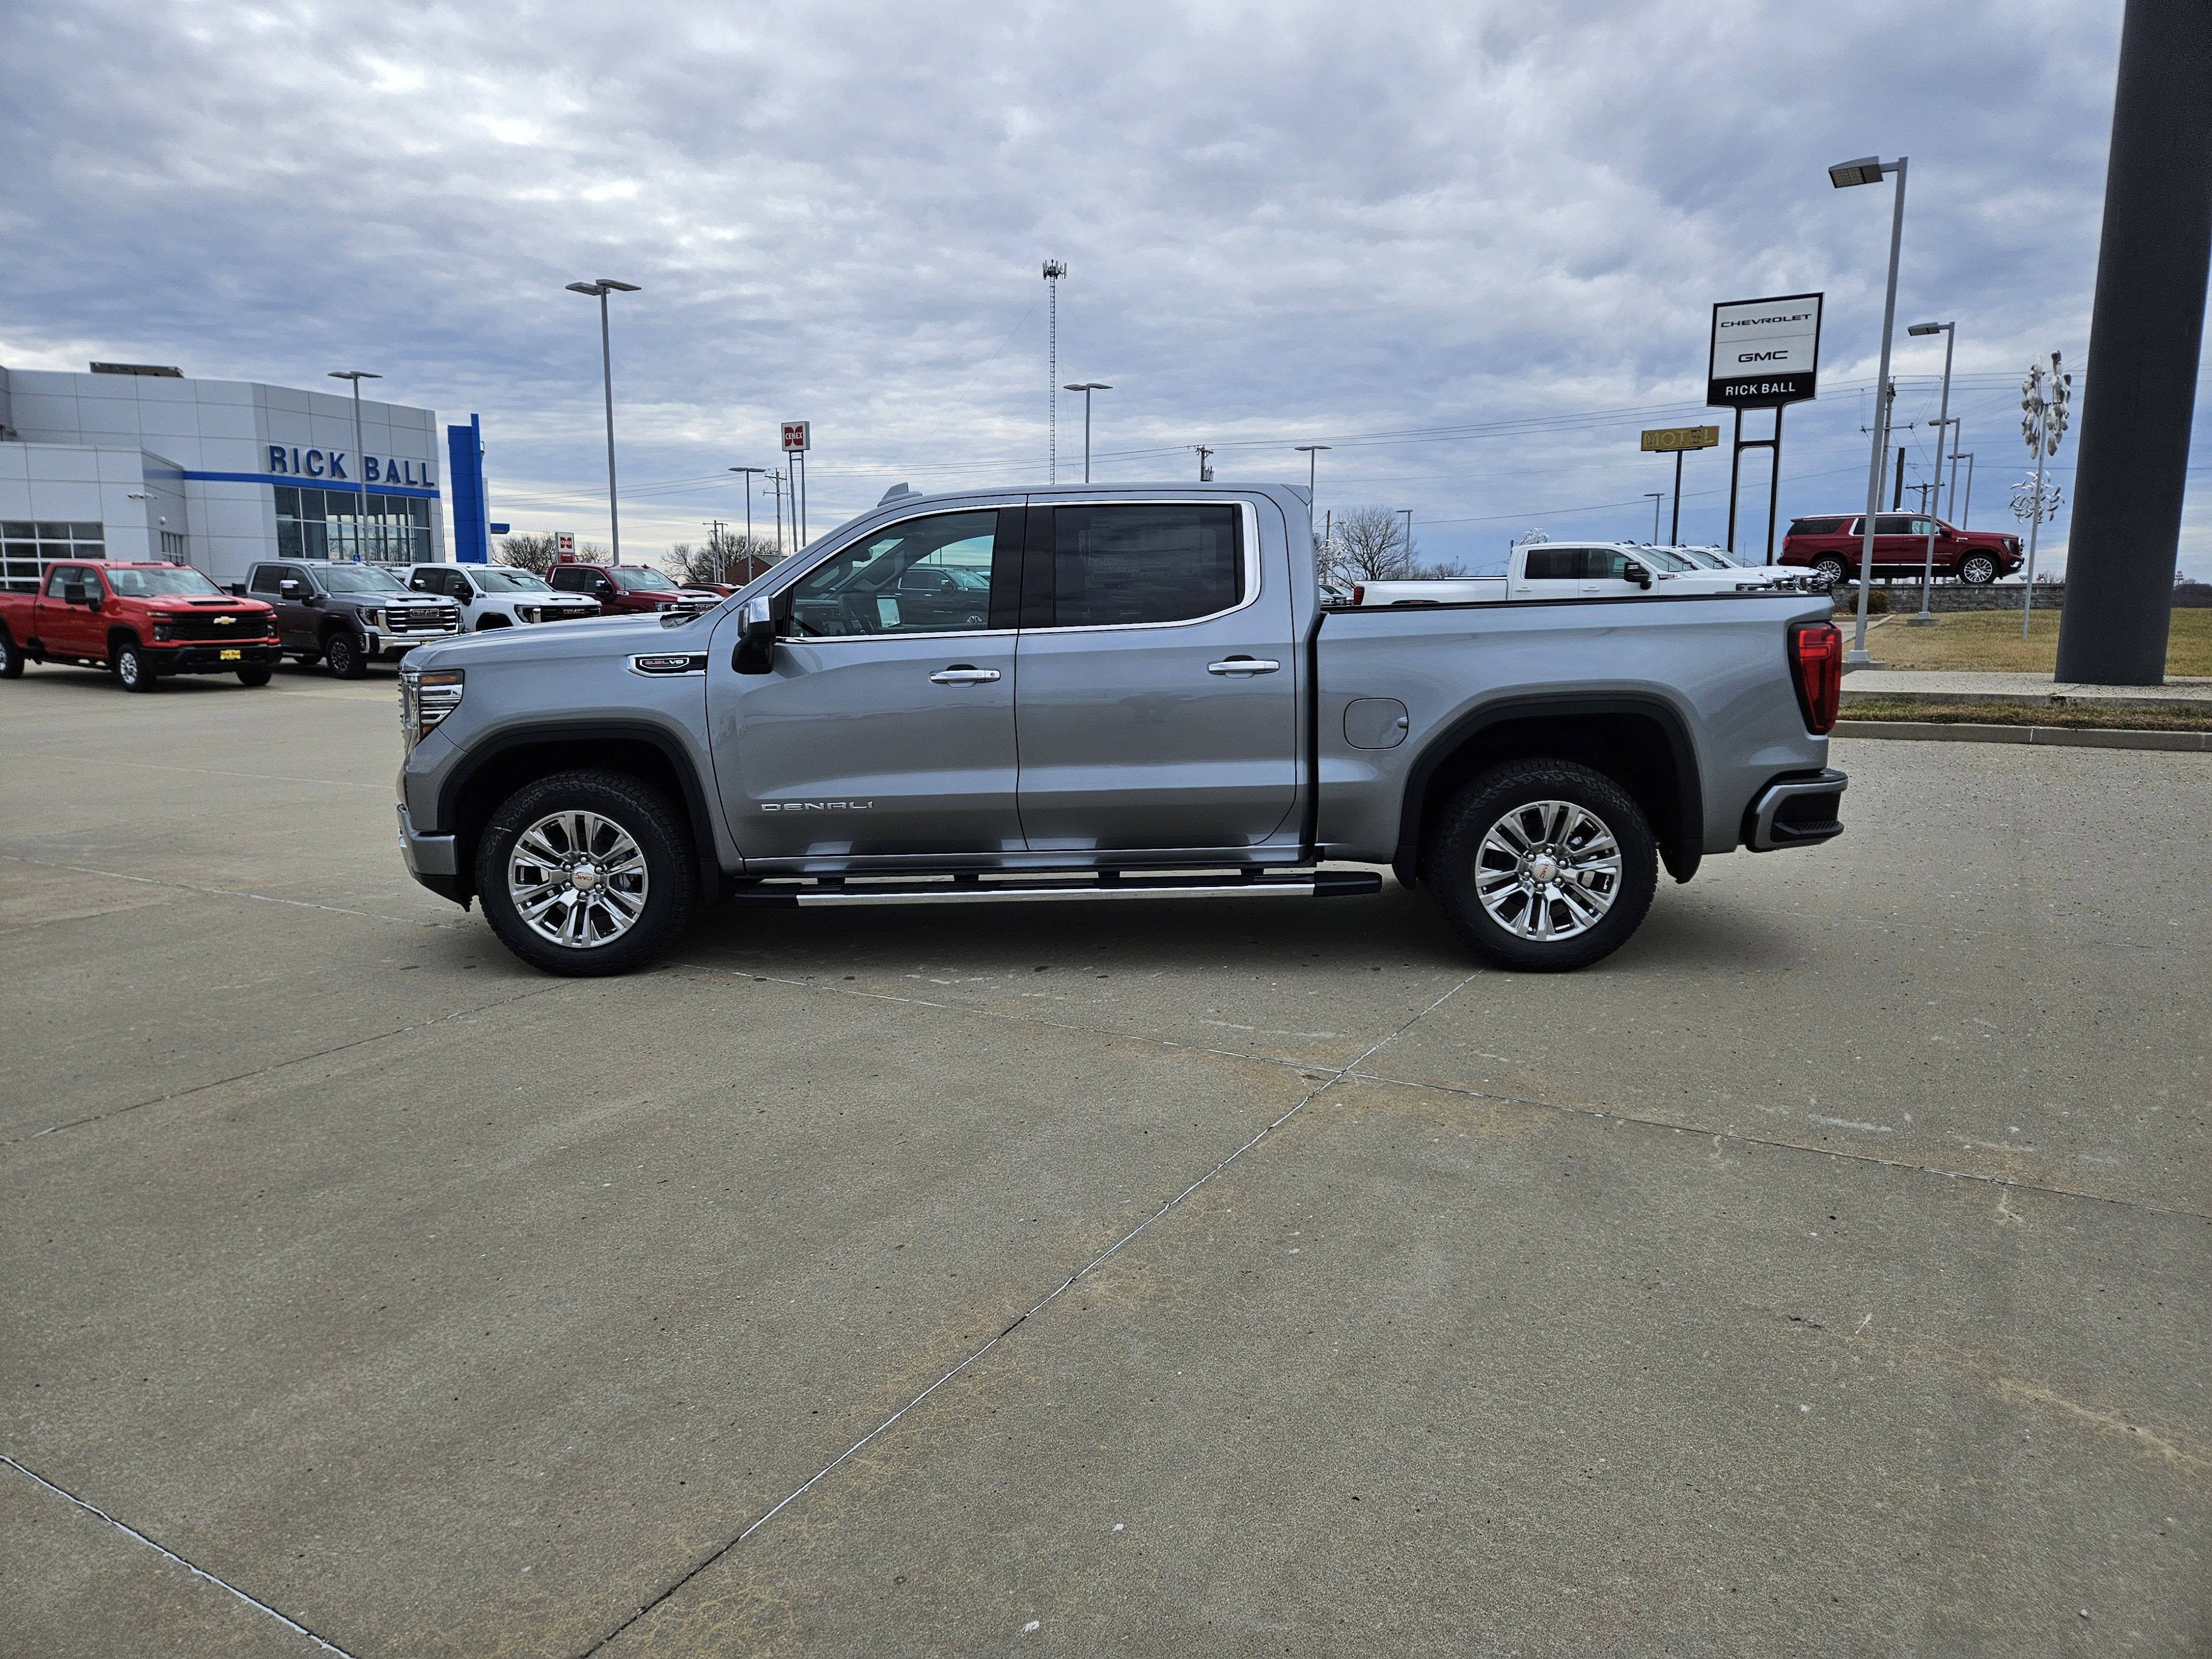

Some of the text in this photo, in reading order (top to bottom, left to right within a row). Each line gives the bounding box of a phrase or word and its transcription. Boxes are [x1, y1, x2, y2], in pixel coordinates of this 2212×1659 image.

[1721, 314, 1812, 327] CHEVROLET
[1738, 350, 1788, 363] GMC
[1726, 382, 1796, 396] RICK BALL
[1644, 429, 1714, 447] MOTEL
[269, 445, 435, 487] RICK BALL
[761, 801, 874, 811] DENALI
[1540, 860, 1550, 879] GMC
